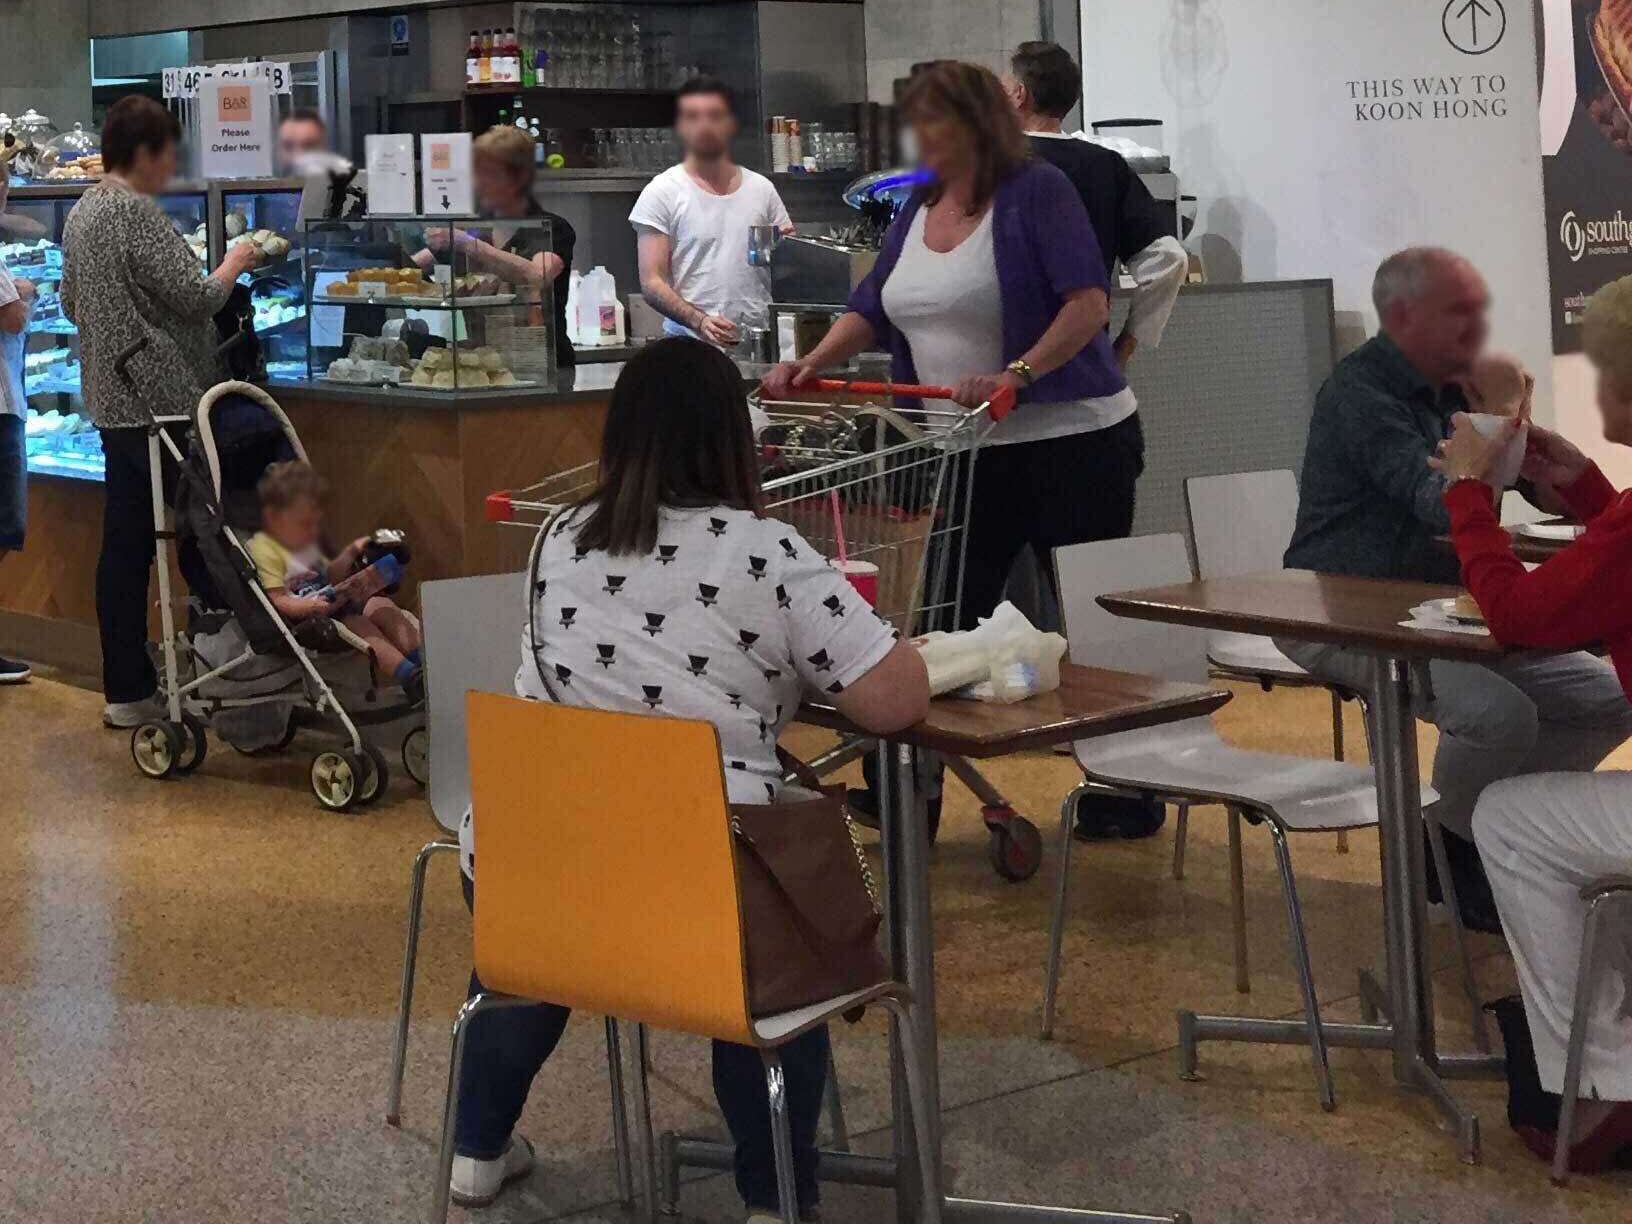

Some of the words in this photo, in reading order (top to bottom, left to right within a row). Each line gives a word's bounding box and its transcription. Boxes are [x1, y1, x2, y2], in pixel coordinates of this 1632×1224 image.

[1345, 79, 1404, 98] THIS
[1412, 77, 1463, 95] WAY
[1471, 75, 1506, 94] TO
[1355, 101, 1423, 121] KOON
[1433, 99, 1507, 118] HONG
[221, 128, 250, 137] Please
[211, 143, 237, 153] Order
[240, 142, 261, 152] Here
